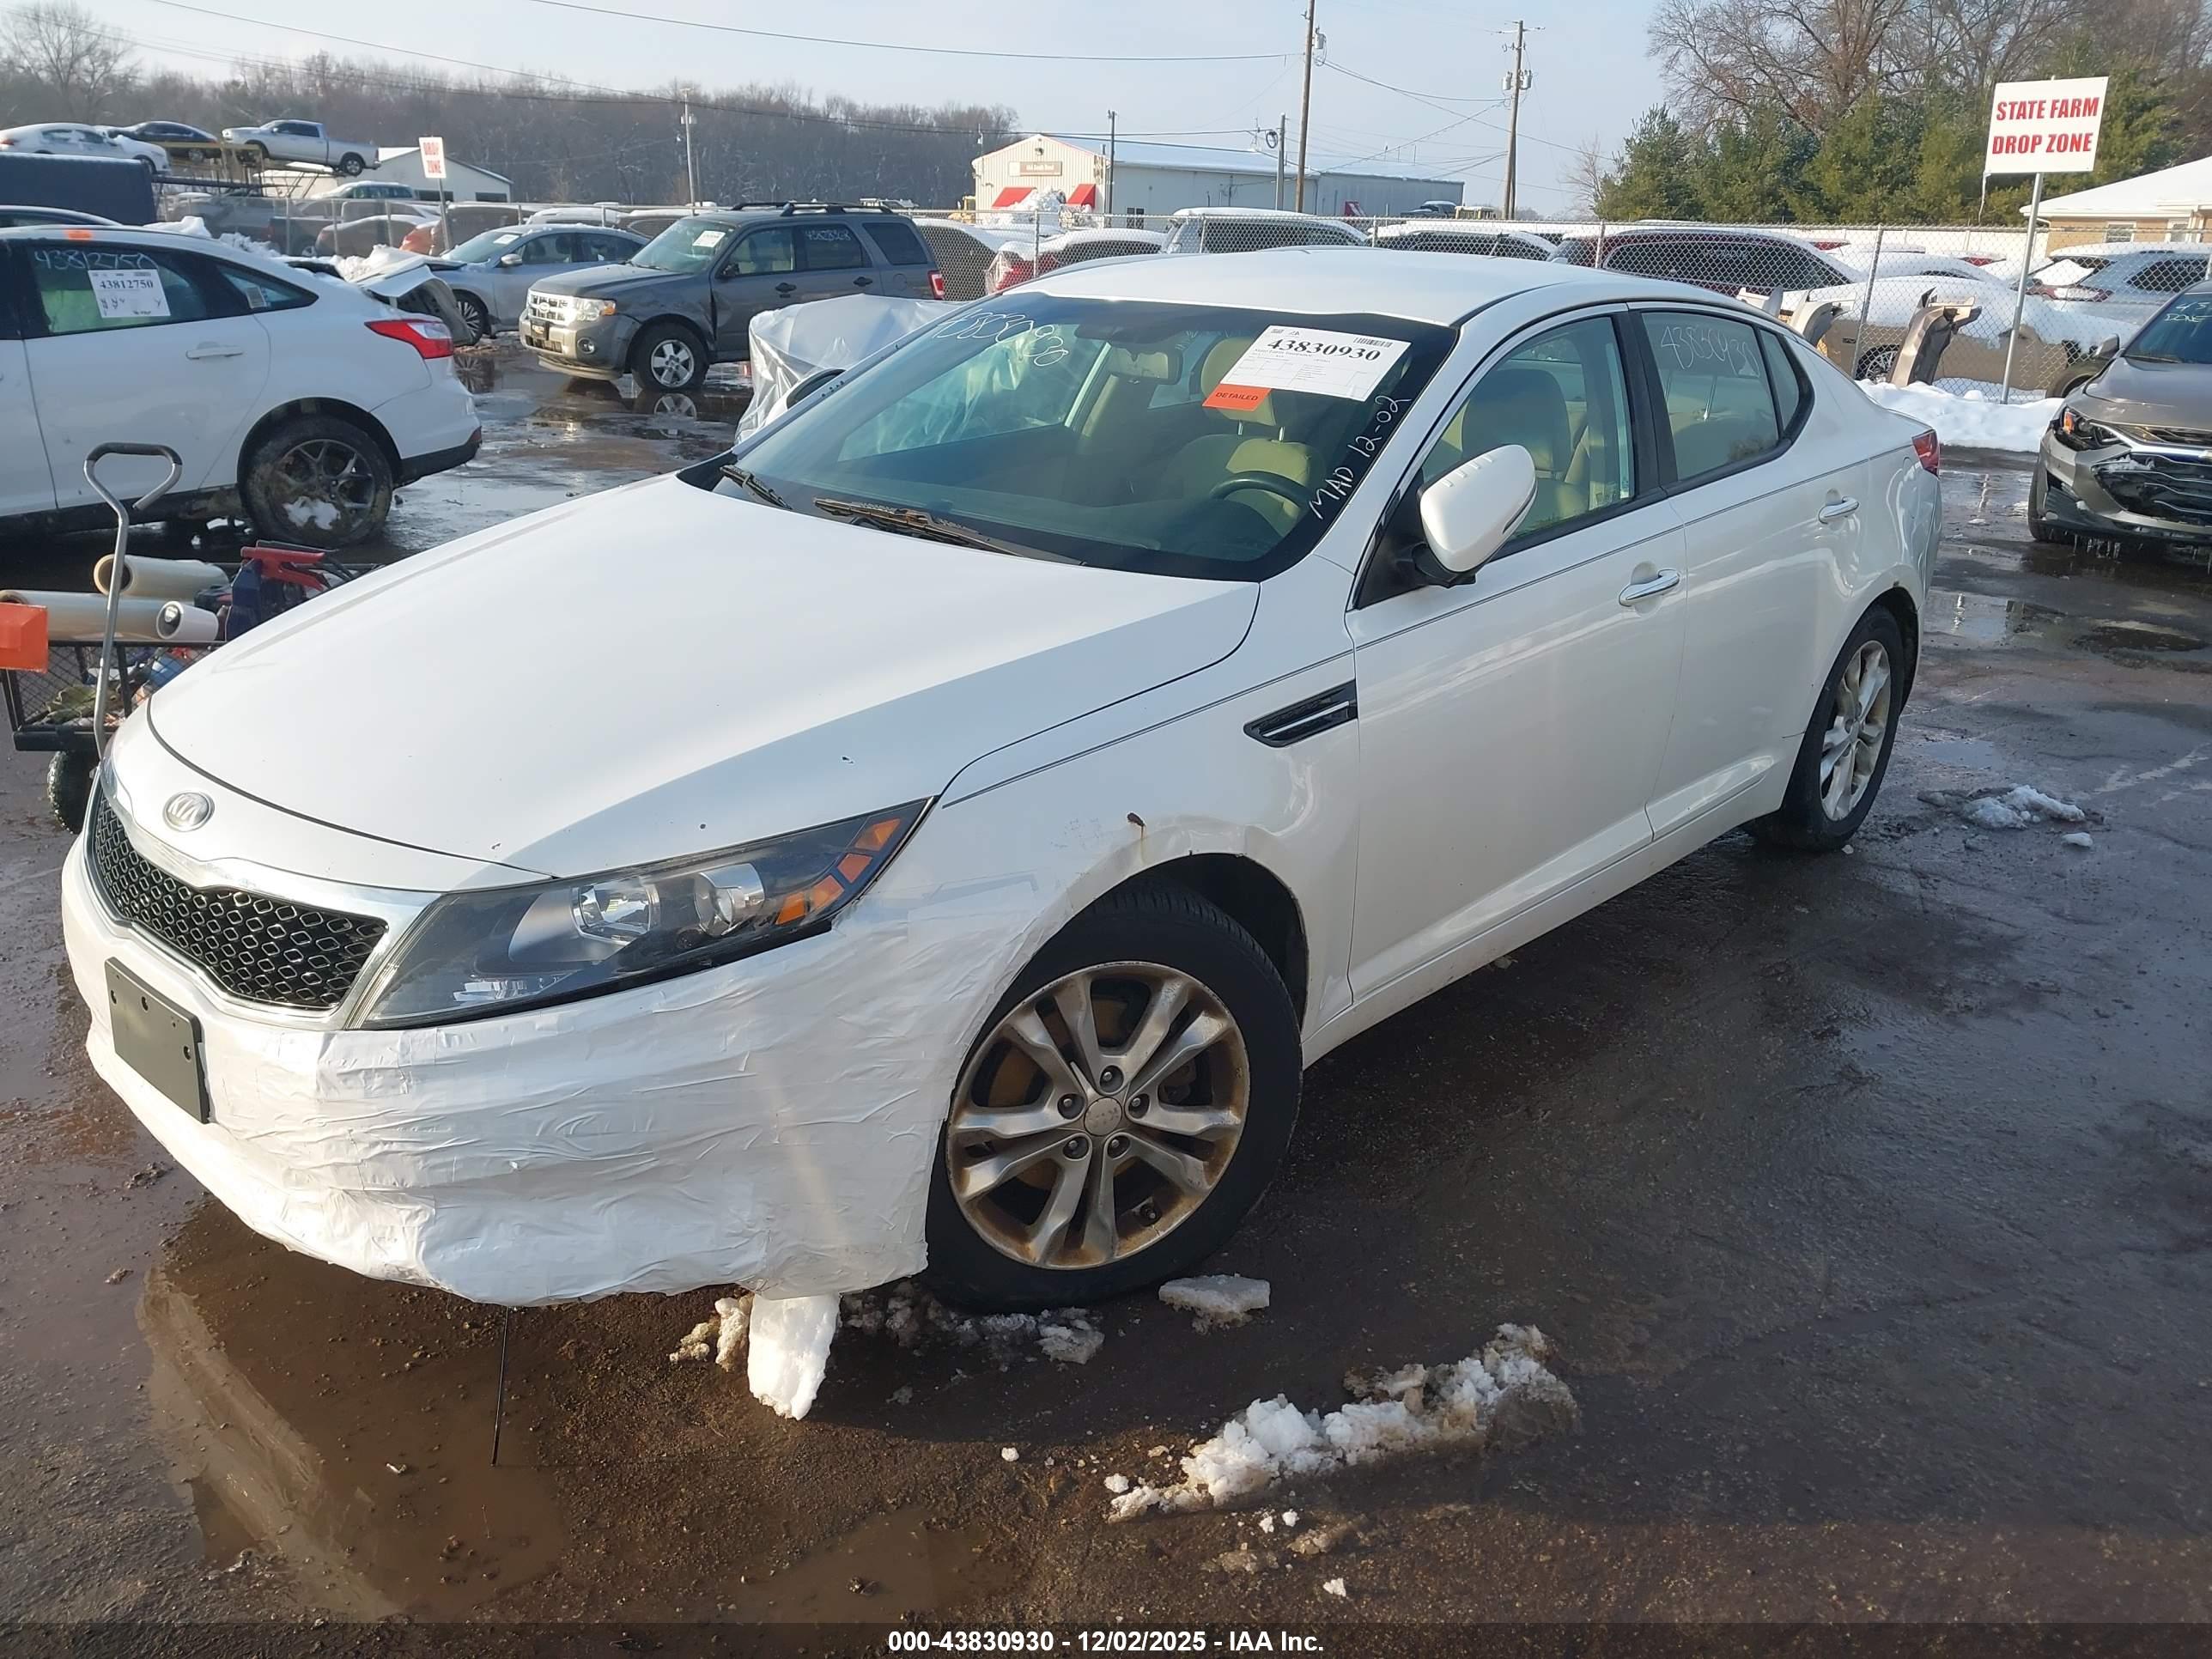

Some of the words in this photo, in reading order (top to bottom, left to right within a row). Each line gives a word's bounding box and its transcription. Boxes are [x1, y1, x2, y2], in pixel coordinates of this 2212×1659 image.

[1996, 99, 2047, 121] STATE
[2050, 96, 2100, 119] FARM
[1991, 134, 2043, 155] DROP
[2045, 132, 2094, 154] ZONE
[33, 249, 159, 270] 43812750
[99, 279, 154, 289] 43812750
[1267, 338, 1381, 362] 43830930
[1215, 392, 1259, 401] DETAILED
[1308, 466, 1354, 520] MAD
[1347, 395, 1413, 458] 12-02
